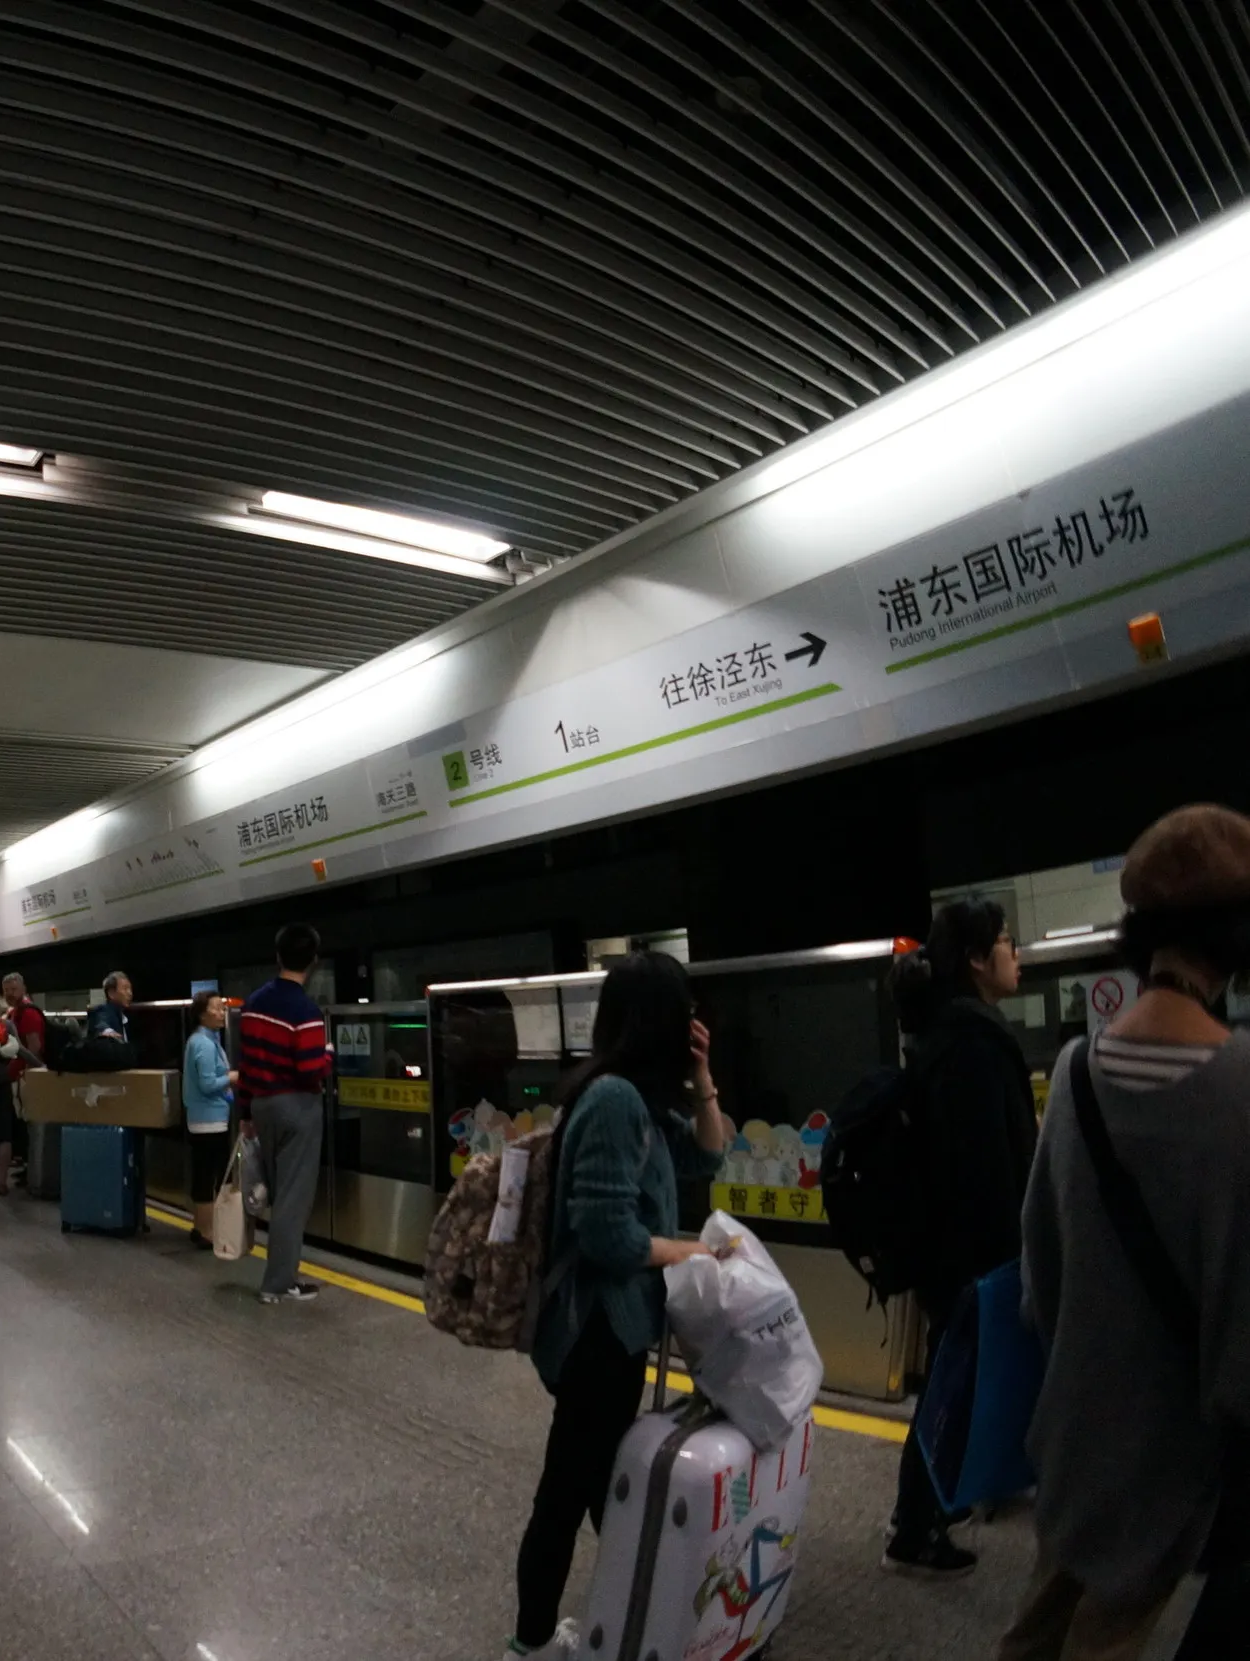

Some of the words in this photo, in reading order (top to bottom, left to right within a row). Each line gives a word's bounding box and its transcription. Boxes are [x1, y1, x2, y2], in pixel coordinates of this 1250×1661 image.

[878, 488, 1148, 633] 浦东国际机场
[889, 625, 937, 650] Pudong
[939, 599, 1014, 635] International
[1016, 579, 1058, 608] Airport
[659, 643, 778, 709] 往徐泾东
[715, 696, 728, 707] To
[730, 688, 750, 703] East
[752, 678, 783, 698] Xujing
[554, 720, 600, 753] 1站台
[450, 761, 463, 781] 2
[470, 744, 502, 770] 号线
[237, 796, 328, 847] 浦东国际机场
[729, 1186, 829, 1222] 智者守
